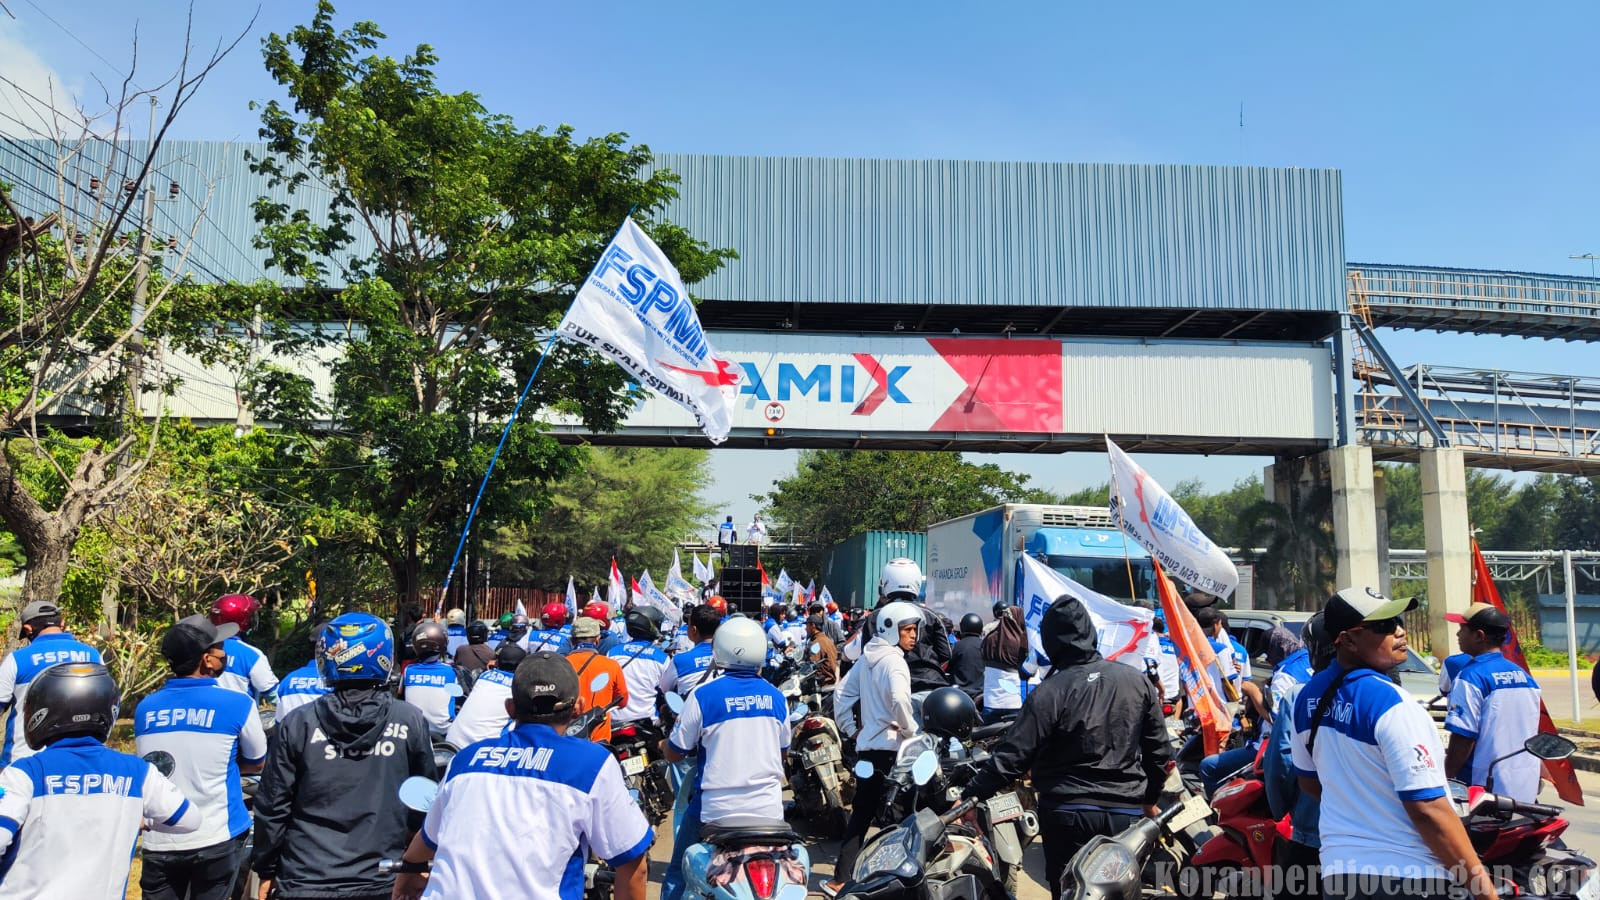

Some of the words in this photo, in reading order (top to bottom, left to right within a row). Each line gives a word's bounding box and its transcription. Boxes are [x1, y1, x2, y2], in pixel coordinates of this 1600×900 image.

[594, 244, 709, 361] FSPMI
[563, 320, 600, 345] PUK
[600, 341, 639, 369] SPAI
[32, 650, 91, 666] FSPMI
[409, 674, 446, 685] FSPMI
[534, 684, 556, 692] POLO
[725, 694, 773, 713] FSPMI
[145, 708, 216, 729] FSPMI
[469, 746, 554, 772] FSPMI
[46, 773, 133, 797] FSPMI
